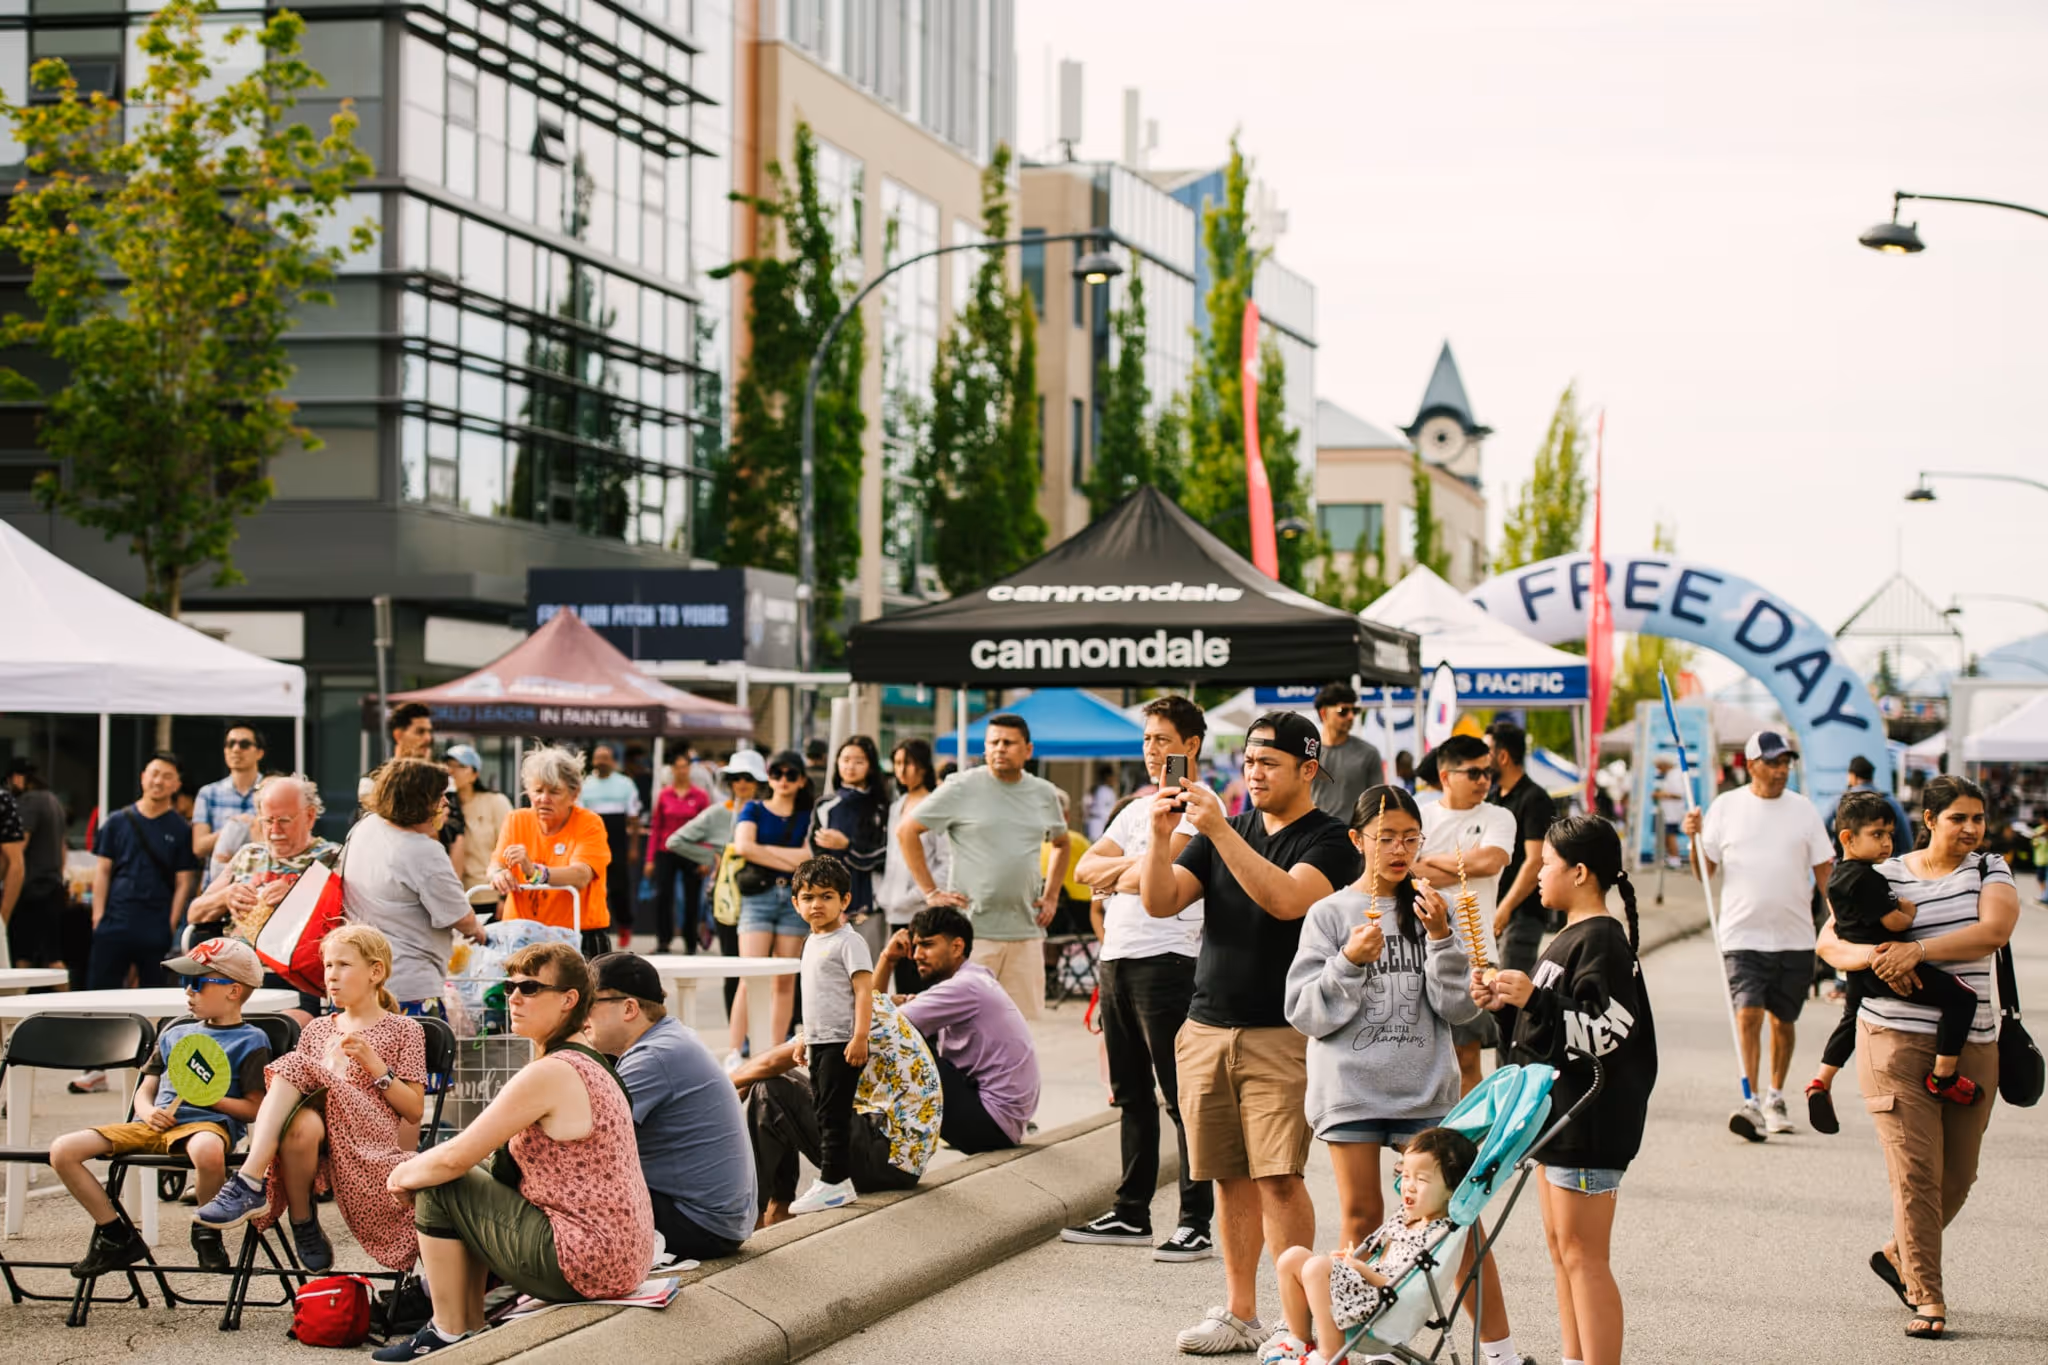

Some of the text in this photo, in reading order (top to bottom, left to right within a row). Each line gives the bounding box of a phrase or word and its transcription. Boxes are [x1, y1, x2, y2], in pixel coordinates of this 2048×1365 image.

[986, 581, 1243, 602] cannondale
[970, 629, 1231, 669] cannondale
[1517, 560, 1728, 626] FREE
[1734, 599, 1870, 732] DAY
[1475, 671, 1565, 695] PACIFIC
[428, 705, 472, 724] ORLD
[475, 705, 535, 724] LEADER
[539, 707, 560, 724] IN
[562, 708, 650, 728] PAINTBALL
[1364, 972, 1421, 1025] 99
[1352, 1025, 1426, 1052] Champions
[1394, 1025, 1410, 1034] STAR
[190, 1058, 211, 1082] VCC
